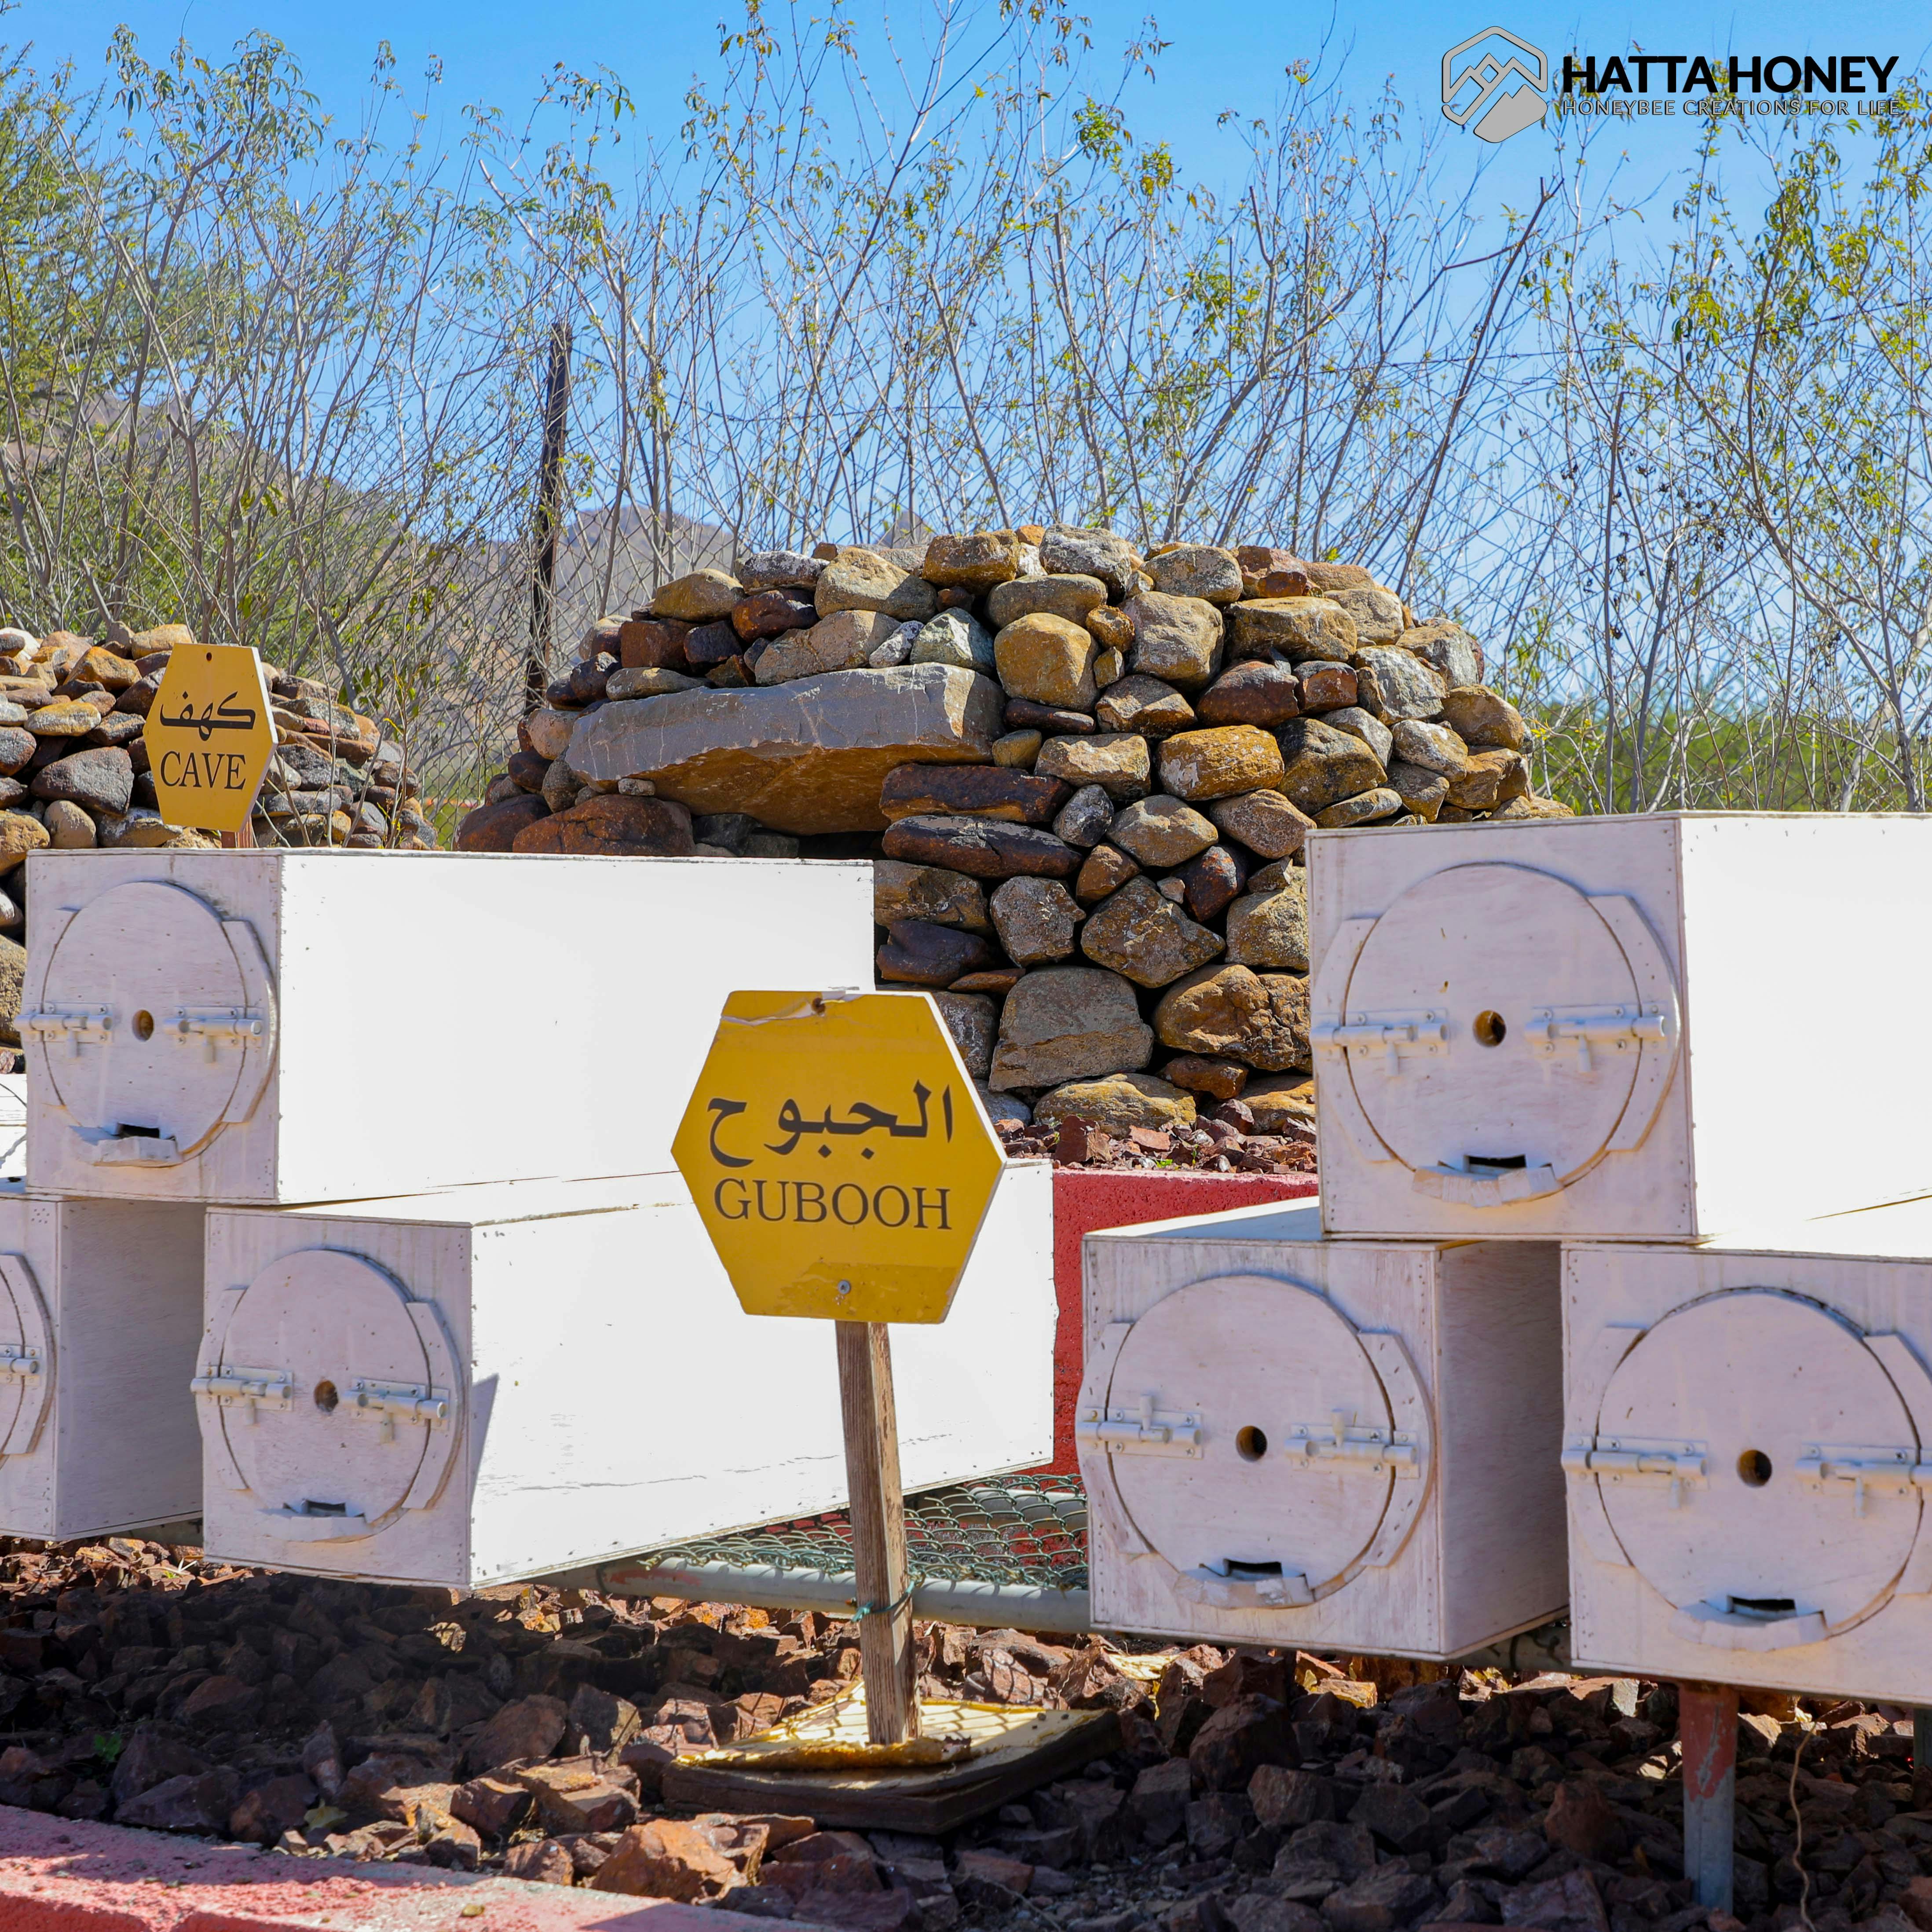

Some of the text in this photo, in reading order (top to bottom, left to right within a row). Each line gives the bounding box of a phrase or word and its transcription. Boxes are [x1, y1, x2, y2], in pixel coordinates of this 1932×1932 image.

[160, 691, 256, 741] كهف
[160, 750, 246, 790] CAVE
[707, 1079, 954, 1168] الجبوح
[714, 1177, 952, 1230] GUBOOH
